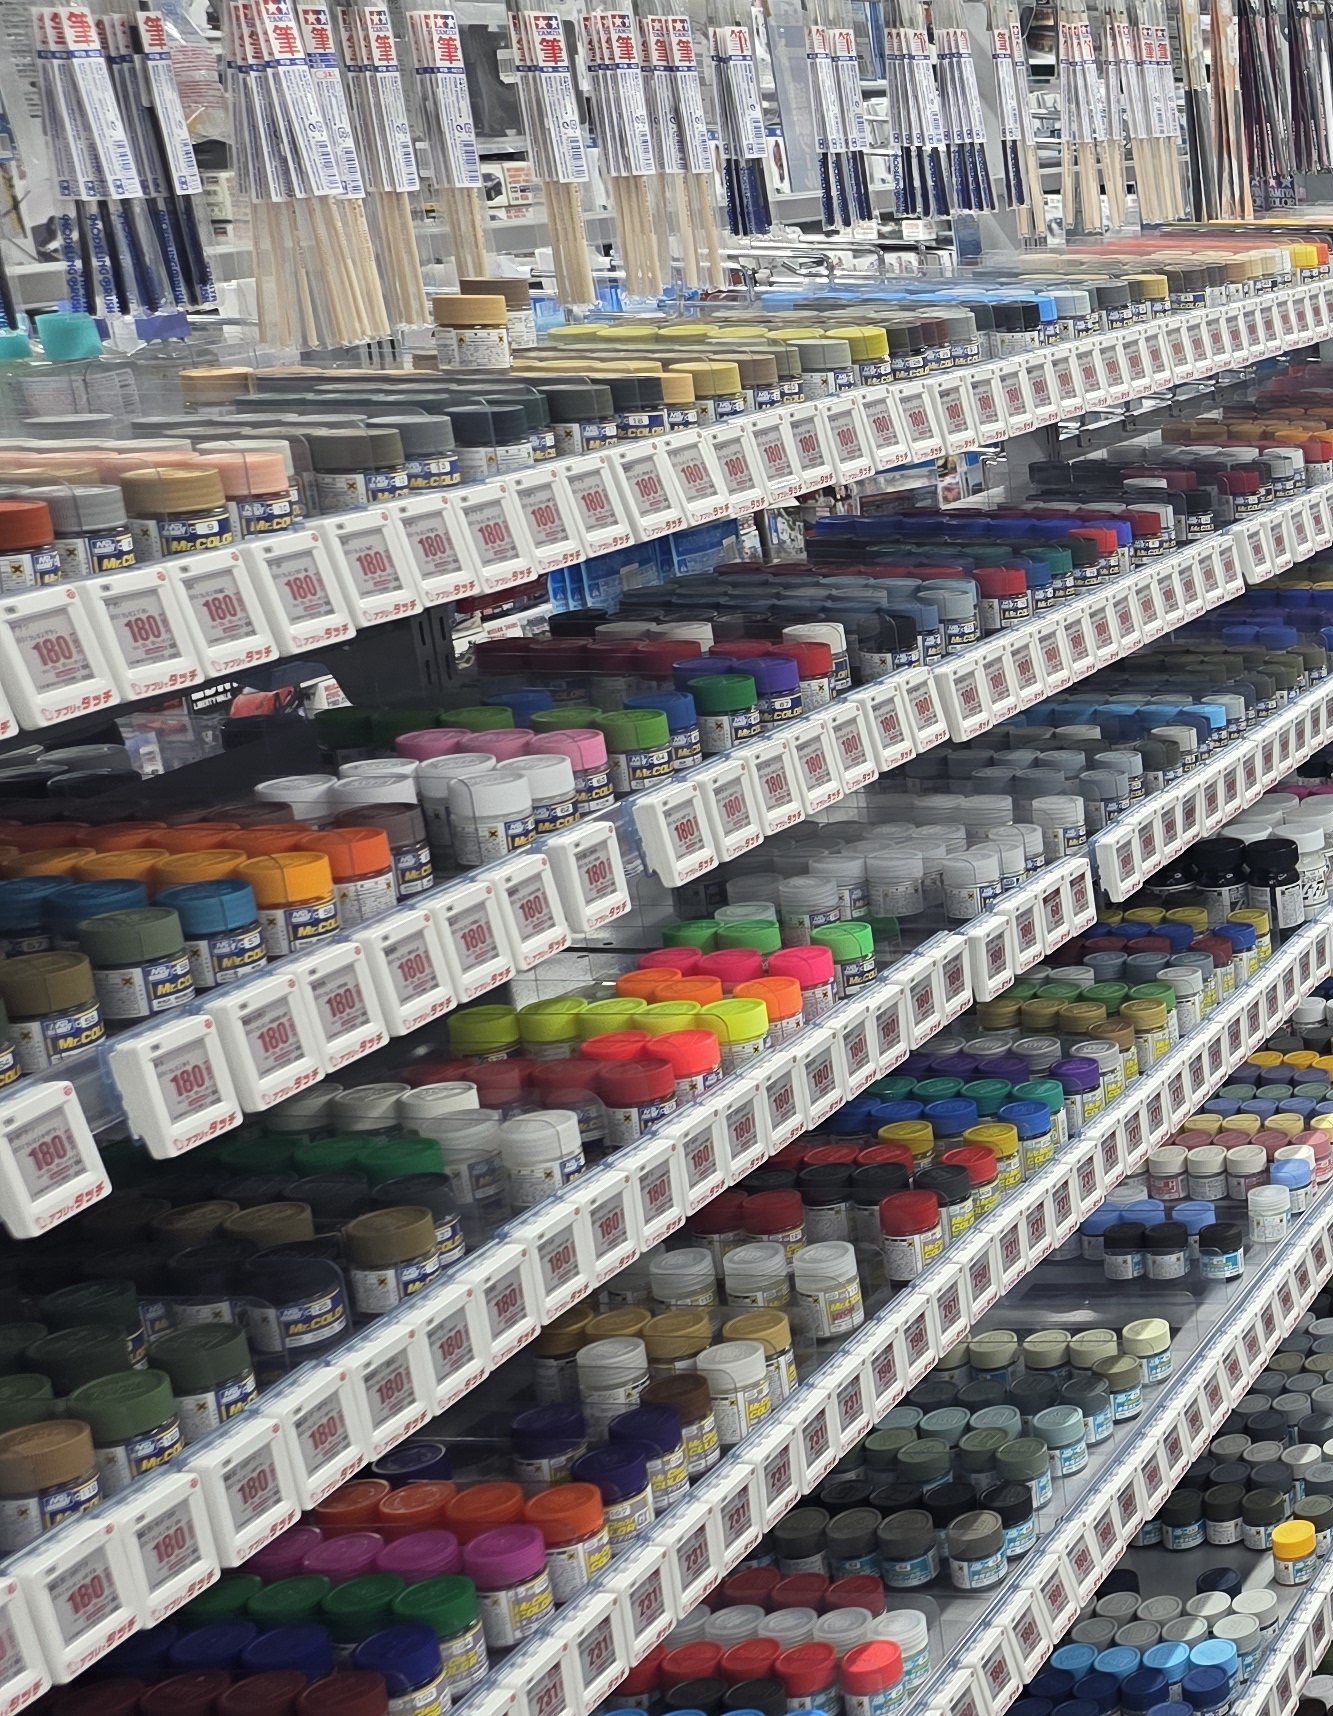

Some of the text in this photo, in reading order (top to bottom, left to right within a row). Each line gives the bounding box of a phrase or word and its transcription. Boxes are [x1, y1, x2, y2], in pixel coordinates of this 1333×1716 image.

[67, 11, 95, 46] 筆
[144, 16, 167, 49] 筆
[272, 25, 301, 55] 筆
[310, 27, 331, 51] 筆
[373, 35, 394, 63] 筆
[437, 35, 461, 64] 筆
[538, 37, 563, 64] 筆
[614, 35, 635, 62] 筆
[677, 39, 694, 64] 筆
[909, 408, 926, 428] 180
[946, 402, 962, 421] 180
[873, 414, 890, 434] 180
[763, 443, 783, 464] 180
[799, 433, 818, 453] 180
[724, 456, 743, 478] 180
[635, 475, 659, 498] 180
[581, 490, 606, 513] 180
[206, 523, 214, 532] 9
[531, 505, 556, 528] 180
[417, 534, 447, 559] 180
[355, 551, 386, 577] 180
[284, 574, 318, 600] 180
[124, 614, 162, 643] 180
[32, 636, 71, 666] 180
[879, 716, 896, 736] 180
[841, 734, 859, 754] 180
[765, 773, 783, 795] 180
[723, 796, 743, 817] 180
[674, 819, 696, 842] 180
[519, 897, 543, 922] 180
[461, 932, 487, 955] 180
[398, 958, 425, 981] 180
[258, 1022, 288, 1051] 180
[171, 1069, 206, 1097] 180
[812, 1068, 829, 1090] 180
[734, 1118, 752, 1141] 180
[28, 1136, 67, 1172] 180
[691, 1146, 710, 1169] 180
[308, 1416, 339, 1449] 180
[151, 1526, 187, 1563] 180
[66, 1575, 105, 1615] 180
